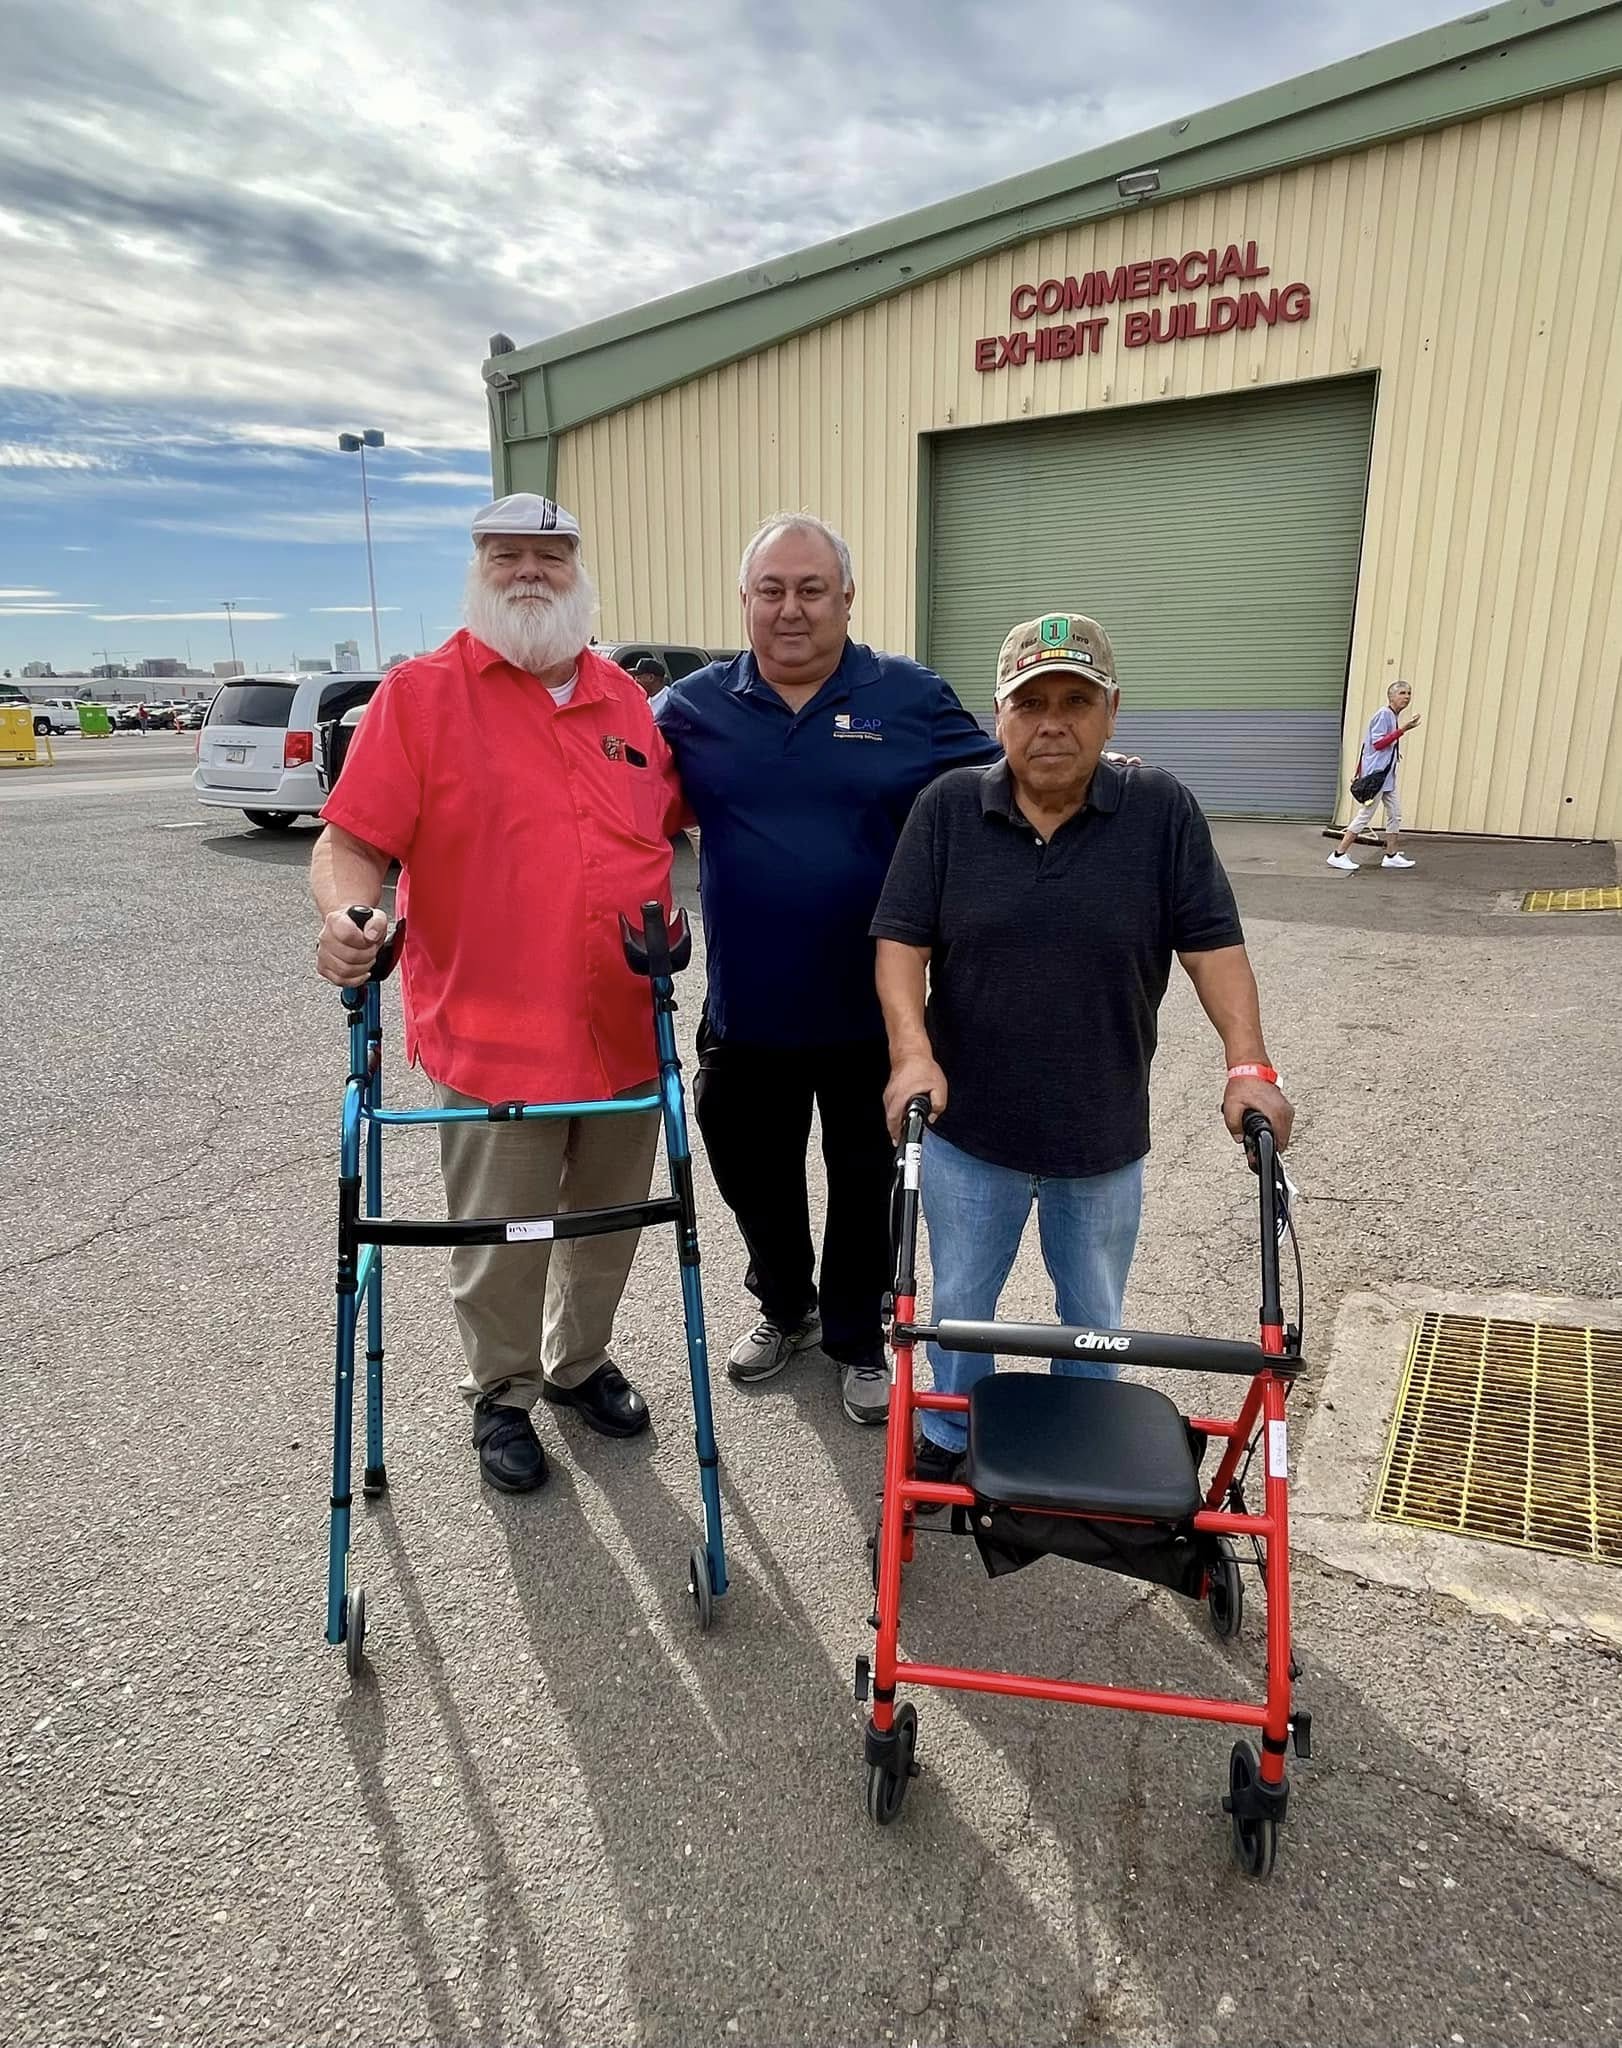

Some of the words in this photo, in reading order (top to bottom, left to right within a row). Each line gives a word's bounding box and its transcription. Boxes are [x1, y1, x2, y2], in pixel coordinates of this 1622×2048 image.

[1010, 240, 1269, 320] COMMERCIAL
[975, 317, 1109, 371] EXHIBIT
[1124, 282, 1311, 347] BUILDING
[1049, 622, 1061, 640] 1
[851, 718, 882, 730] CAP
[1074, 1331, 1131, 1351] drive
